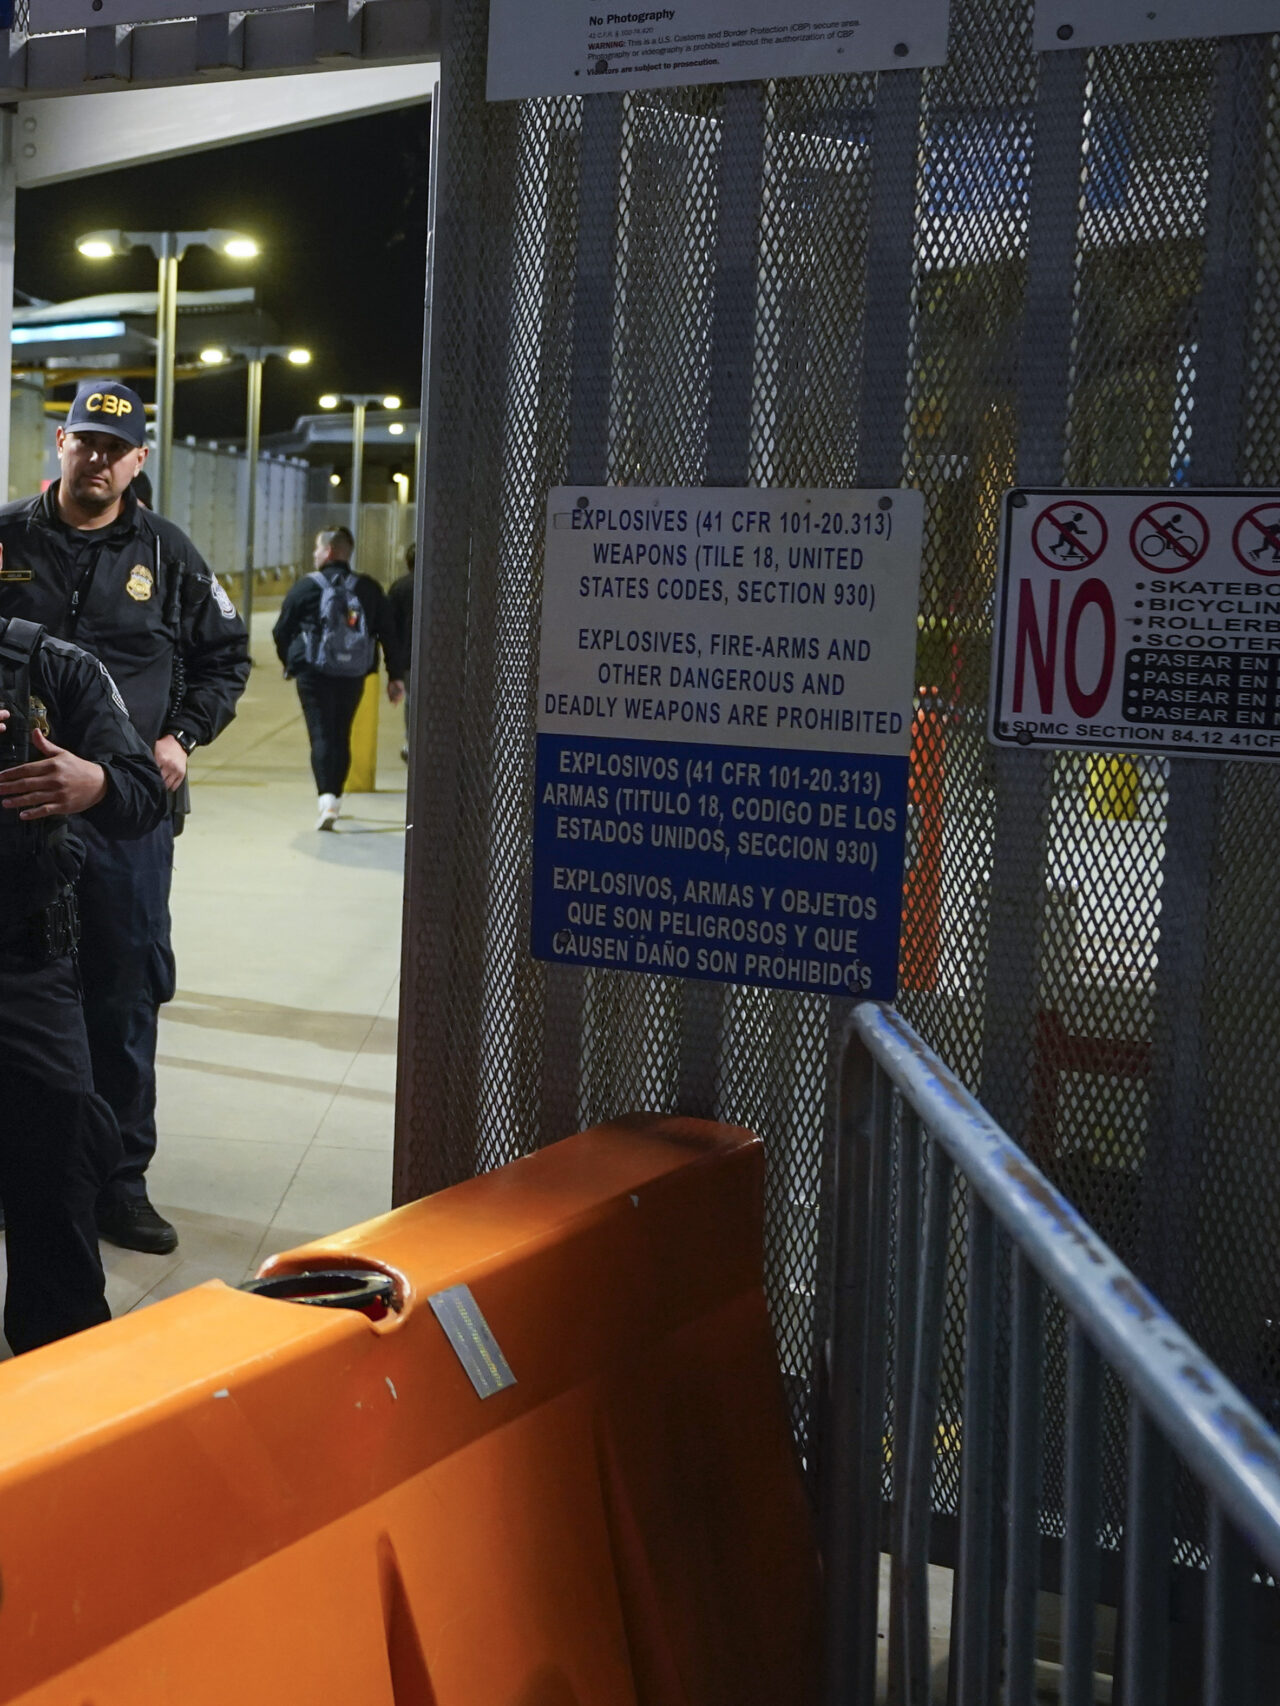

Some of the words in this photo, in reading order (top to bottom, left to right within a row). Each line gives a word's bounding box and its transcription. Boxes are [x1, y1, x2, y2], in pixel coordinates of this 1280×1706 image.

[589, 16, 603, 26] No
[607, 9, 675, 24] Photography
[588, 41, 626, 50] WARNING:
[658, 36, 671, 44] U.S.
[674, 34, 705, 42] Customs
[724, 30, 747, 38] Border
[751, 24, 788, 34] Protection
[790, 22, 810, 32] (CBP)
[814, 22, 838, 30] secure
[588, 51, 630, 61] Photography
[641, 45, 683, 56] videography
[694, 42, 729, 51] prohibited
[775, 32, 824, 44] authorization
[837, 30, 854, 38] CBP.
[587, 68, 618, 76] Vitors
[634, 63, 662, 72] subject
[673, 58, 720, 69] prosecution.
[86, 392, 132, 417] CBP
[572, 508, 687, 531] EXPLOSIVES
[696, 511, 721, 537] (41
[732, 511, 770, 533] CFR
[781, 512, 891, 541] 101-20.313)
[594, 543, 686, 566] WEAPONS
[696, 545, 744, 571] (TILE
[754, 547, 778, 572] 18,
[789, 547, 863, 569] UNITED
[580, 576, 648, 599] STATES
[658, 579, 728, 605] CODES,
[738, 581, 825, 604] SECTION
[835, 583, 875, 611] 930)
[1150, 580, 1280, 596] SKATEBO
[1149, 598, 1280, 615] BICYCLIN
[1148, 616, 1280, 633] ROLLERB
[579, 629, 701, 657] EXPLOSIVES,
[711, 634, 819, 659] FIRE-ARMS
[827, 639, 870, 661] AND
[1012, 578, 1116, 719] NO
[1147, 634, 1280, 650] SCOOTER
[1145, 653, 1231, 668] PASEAR
[1240, 657, 1269, 670] EN
[599, 663, 661, 686] OTHER
[670, 667, 794, 693] DANGEROUS
[802, 673, 844, 695] AND
[1144, 671, 1230, 686] PASEAR
[1239, 675, 1267, 688] EN
[1143, 688, 1229, 704] PASEAR
[1238, 693, 1266, 706] EN
[546, 694, 617, 717] DEADLY
[625, 698, 720, 724] WEAPONS
[728, 704, 768, 726] ARE
[777, 707, 902, 734] PROHIBITED
[1142, 706, 1227, 722] PASEAR
[1237, 711, 1265, 724] EN
[1013, 721, 1069, 735] SDMC
[1076, 724, 1164, 741] SECTION
[1172, 730, 1223, 744] 84.12
[1231, 734, 1280, 748] 41CF
[560, 751, 678, 780] EXPLOSIVOS
[686, 760, 712, 787] (41
[722, 762, 760, 786] CFR
[770, 766, 880, 800] 101-20.313)
[543, 783, 608, 808] ARMAS
[616, 788, 690, 815] (TITULO
[699, 795, 723, 822] 18,
[732, 797, 811, 824] CODIGO
[820, 804, 847, 827] DE
[855, 806, 896, 831] LOS
[557, 817, 643, 844] ESTADOS
[652, 824, 729, 857] UNIDOS,
[738, 832, 828, 861] SECCION
[836, 840, 877, 872] 930)
[554, 867, 676, 908] EXPLOSIVOS,
[684, 880, 753, 908] ARMAS
[761, 887, 775, 909] Y
[782, 889, 876, 920] OBJETOS
[568, 902, 606, 926] QUE
[614, 907, 652, 931] SON
[660, 911, 786, 945] PELIGROSOS
[795, 925, 807, 947] Y
[815, 927, 857, 953] QUE
[553, 929, 628, 961] CAUSEN
[636, 940, 689, 968] DAÑO
[697, 949, 737, 973] SON
[744, 953, 872, 989] PROHIBIDOS
